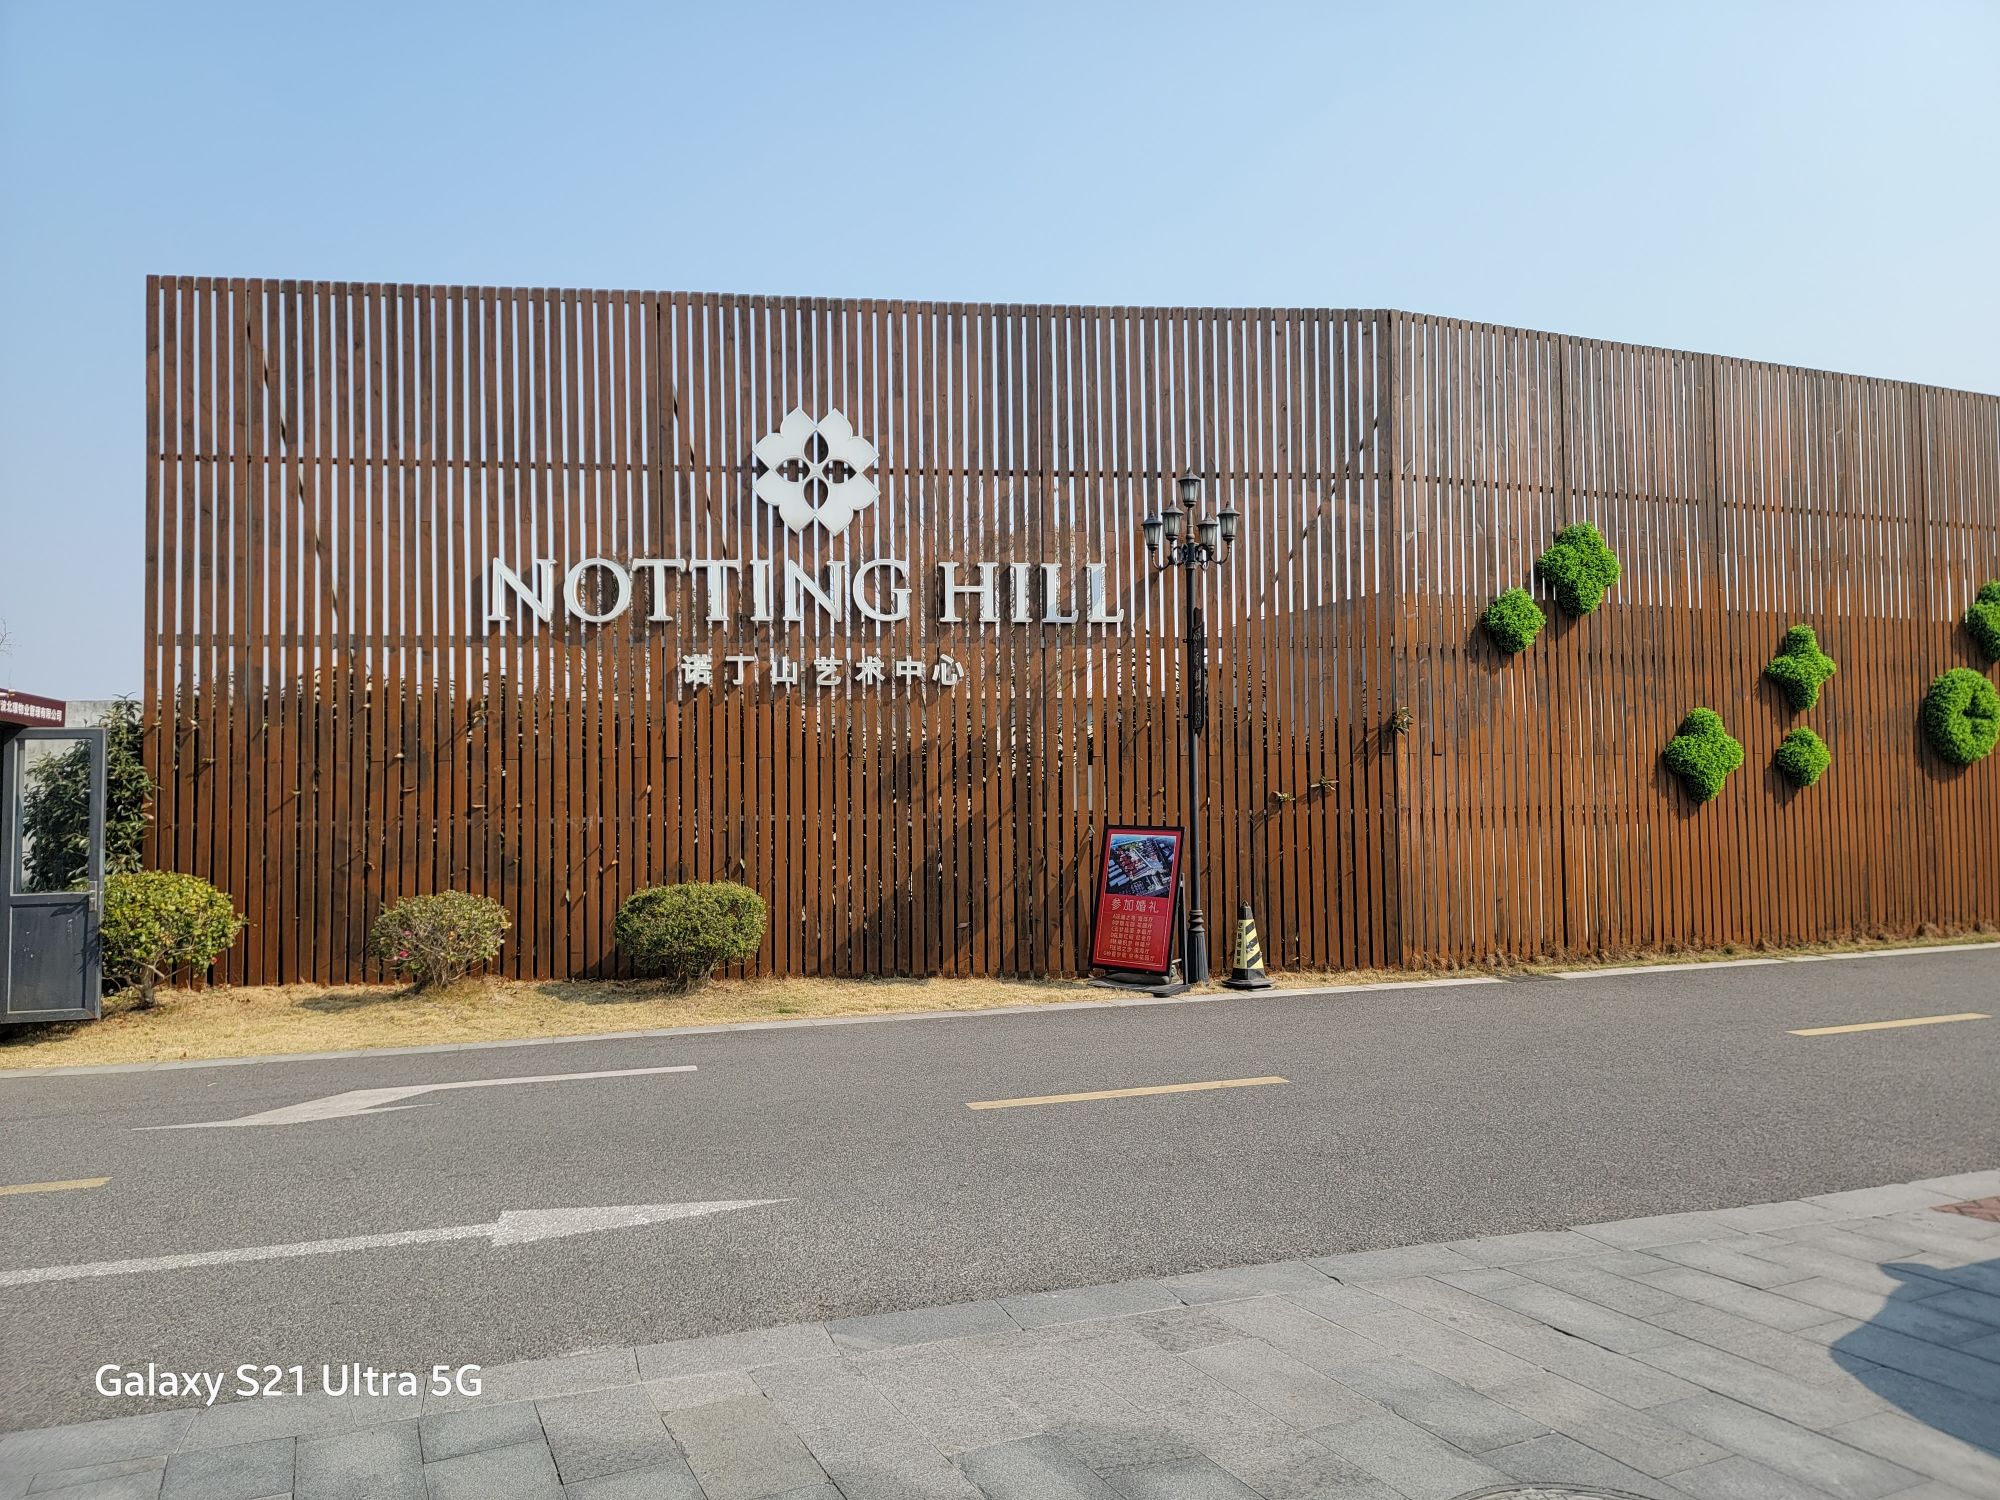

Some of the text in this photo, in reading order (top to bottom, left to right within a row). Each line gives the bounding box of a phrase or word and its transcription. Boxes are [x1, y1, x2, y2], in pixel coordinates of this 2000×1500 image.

[487, 556, 1124, 624] NOTTING HILL
[681, 653, 964, 686] 诺丁山艺术中心
[1111, 897, 1159, 914] 参加婚礼
